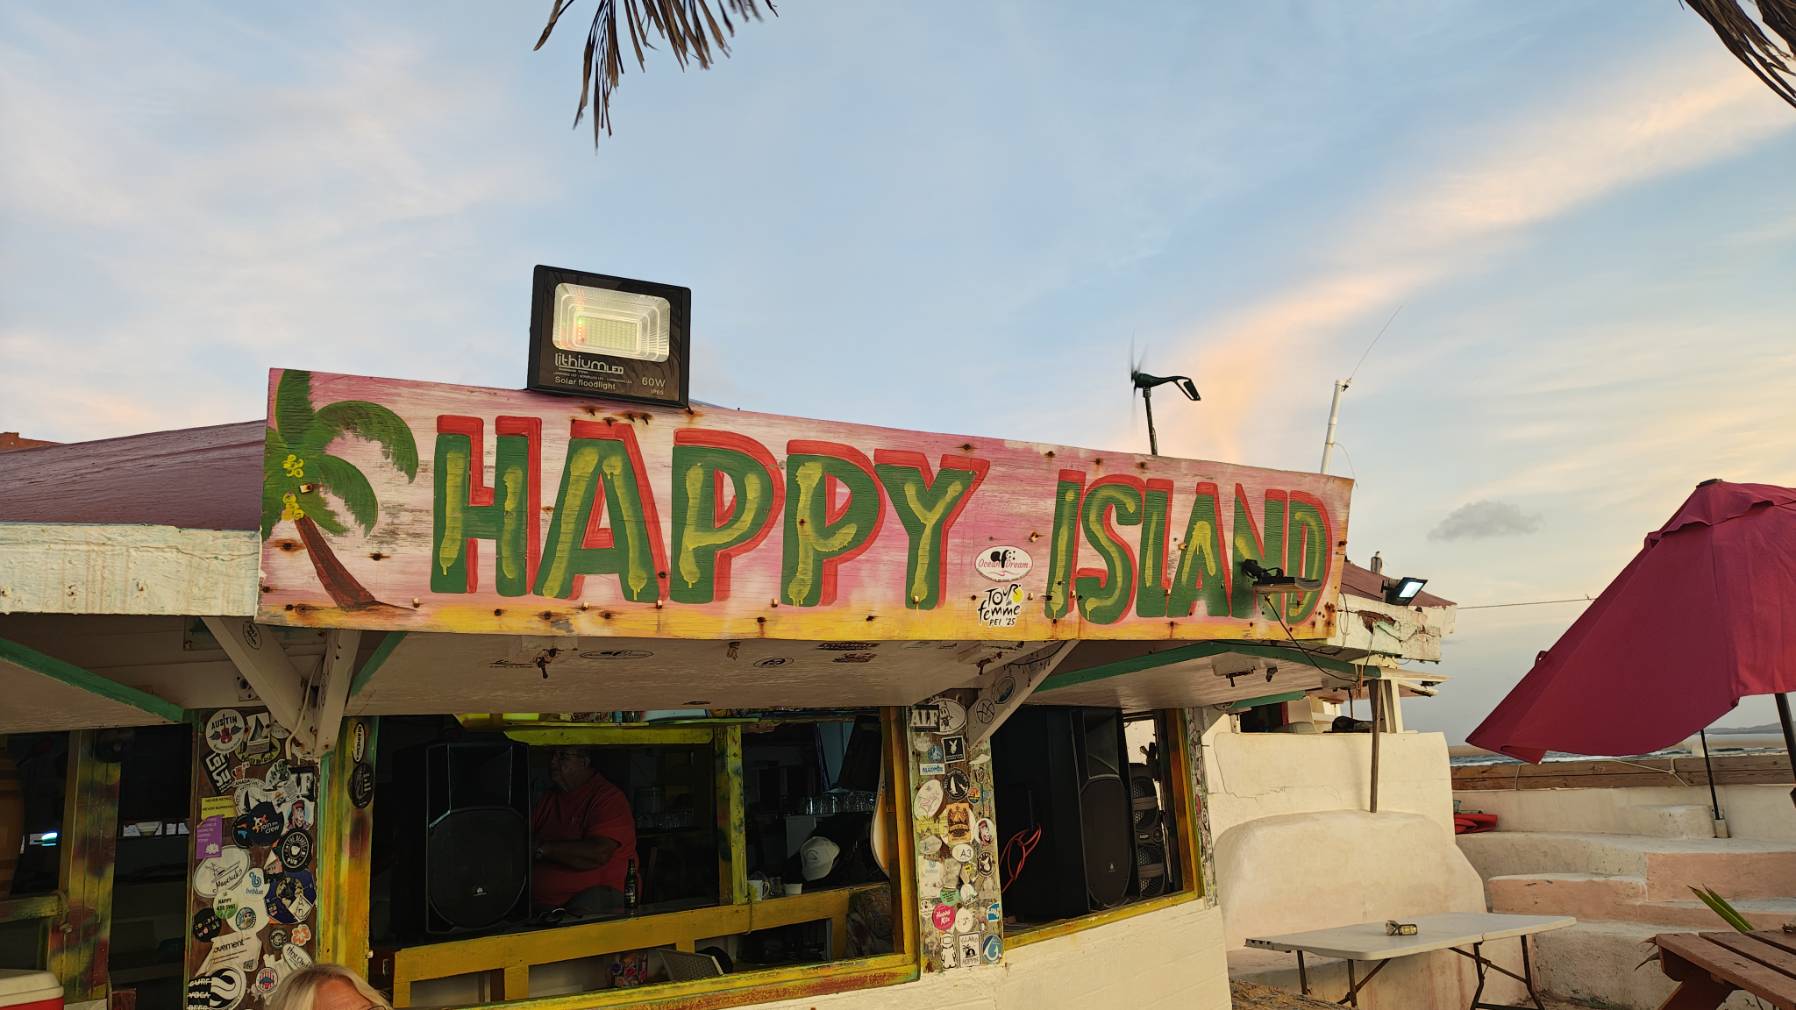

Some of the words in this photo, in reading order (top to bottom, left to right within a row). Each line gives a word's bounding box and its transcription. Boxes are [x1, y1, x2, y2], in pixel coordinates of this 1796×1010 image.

[554, 376, 576, 386] Solar
[578, 377, 616, 391] floodlight
[641, 376, 666, 388] 60W
[431, 415, 990, 608] HAPPY
[1045, 469, 1333, 624] ISLAND
[978, 558, 1000, 568] Ocean
[1005, 560, 1029, 569] Dream
[978, 600, 1021, 624] femme
[211, 713, 238, 730] AUSTIN
[260, 821, 272, 832] join
[265, 824, 280, 834] crew
